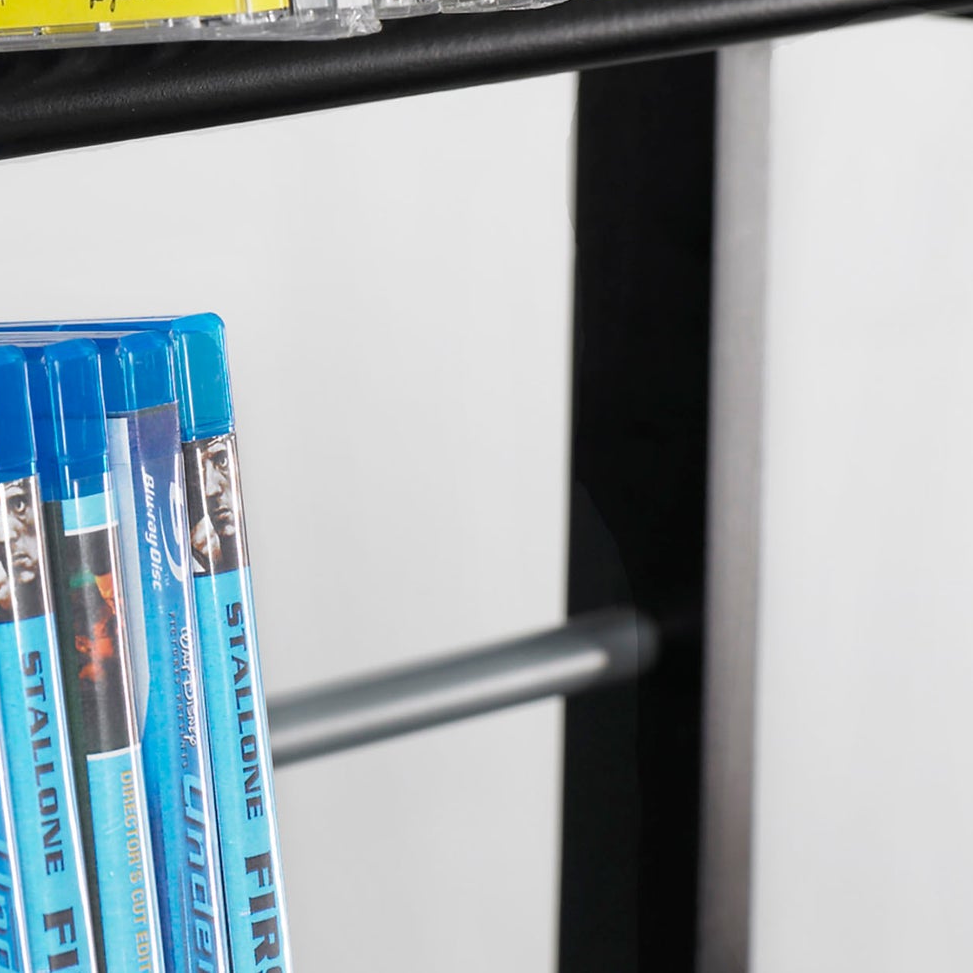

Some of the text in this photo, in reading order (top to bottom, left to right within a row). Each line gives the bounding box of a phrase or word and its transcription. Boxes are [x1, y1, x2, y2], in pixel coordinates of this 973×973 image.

[149, 546, 163, 591] Disc
[183, 676, 199, 748] Disney
[226, 602, 265, 819] STALLONE
[22, 650, 65, 877] STALLONE
[120, 771, 143, 883] DIRECTOR'S
[131, 889, 147, 925] CUT
